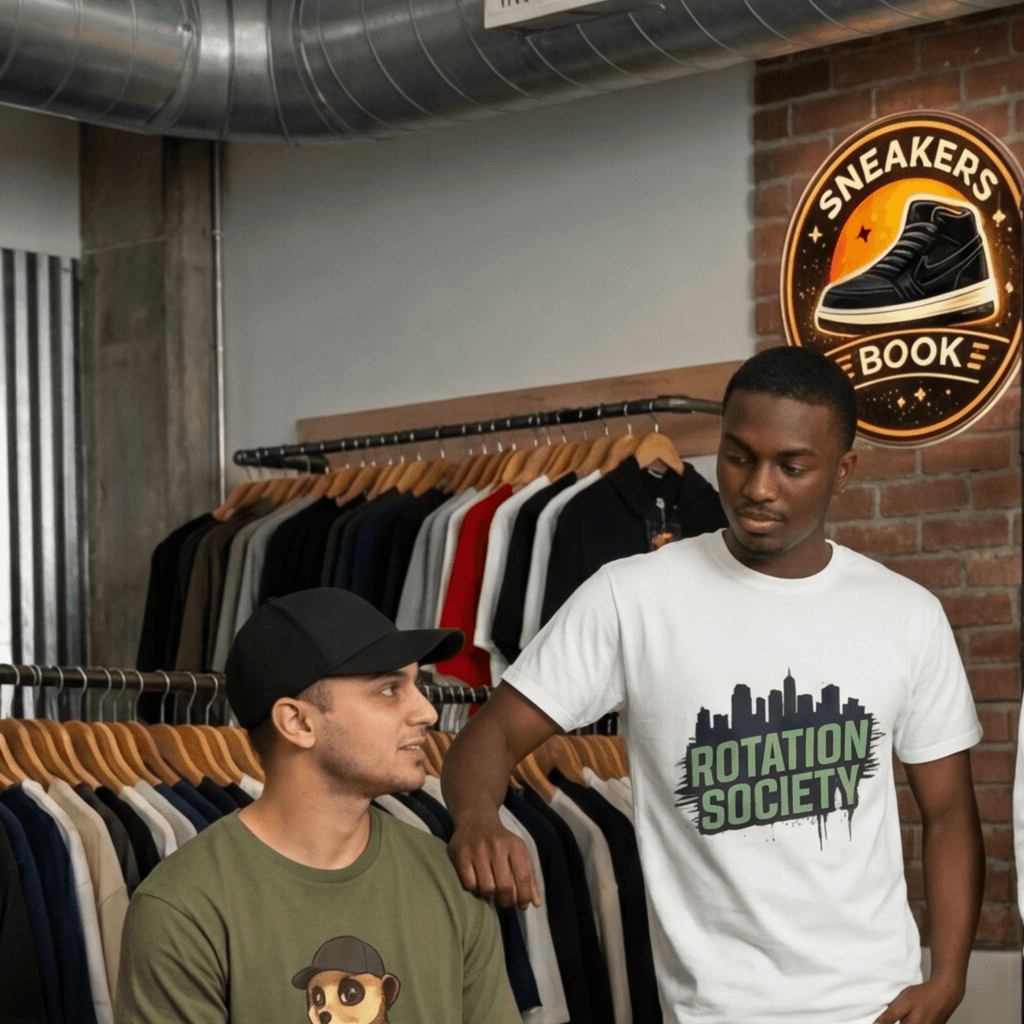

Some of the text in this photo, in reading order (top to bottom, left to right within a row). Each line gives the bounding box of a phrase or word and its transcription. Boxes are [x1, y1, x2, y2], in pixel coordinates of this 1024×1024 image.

[819, 136, 998, 219] SNEAKERS
[859, 337, 964, 376] BOOK
[691, 719, 868, 787] ROTATION
[702, 764, 860, 830] SOCIETY
